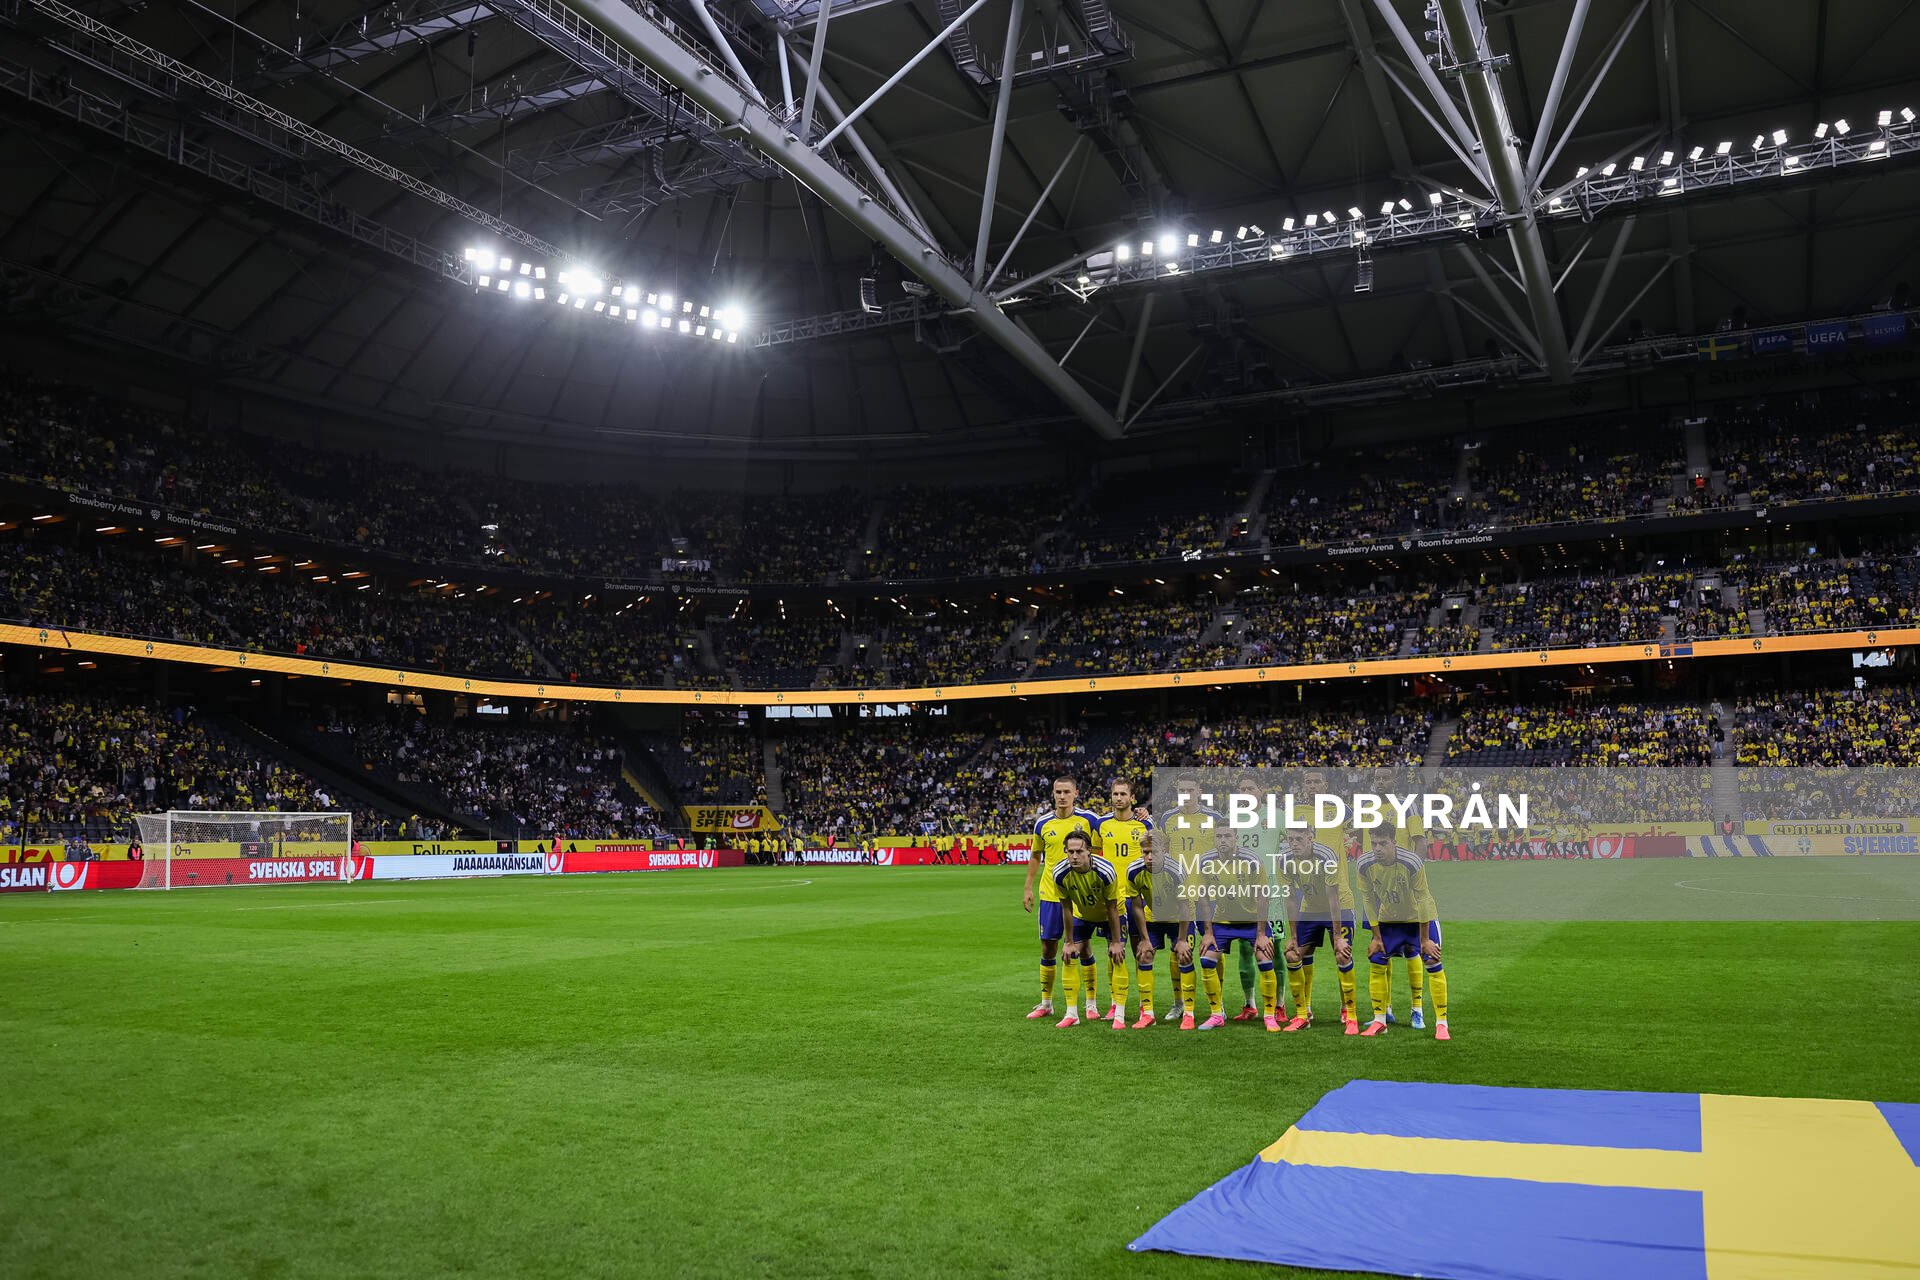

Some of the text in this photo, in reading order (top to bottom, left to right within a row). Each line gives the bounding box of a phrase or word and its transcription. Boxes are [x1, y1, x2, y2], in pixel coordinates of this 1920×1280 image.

[1758, 335, 1787, 346] FIFA
[1809, 331, 1845, 344] UEFA
[69, 493, 237, 535] Strawberry Arena Room for emotions
[1327, 534, 1493, 556] Strawberry Arena Room for emotions
[604, 582, 643, 592] Strawberry
[644, 584, 665, 592] Arena
[706, 586, 717, 594] for
[717, 587, 749, 595] emotions
[696, 818, 731, 828] SPEL
[1181, 837, 1194, 851] 17
[1242, 834, 1260, 848] 23
[1843, 835, 1919, 854] SVERIGE
[1114, 843, 1128, 857] 10
[649, 853, 698, 867] SVENSKA SPEL
[249, 860, 337, 879] SVENSKA SPEL
[1081, 894, 1097, 907] 19
[1386, 890, 1399, 904] 18
